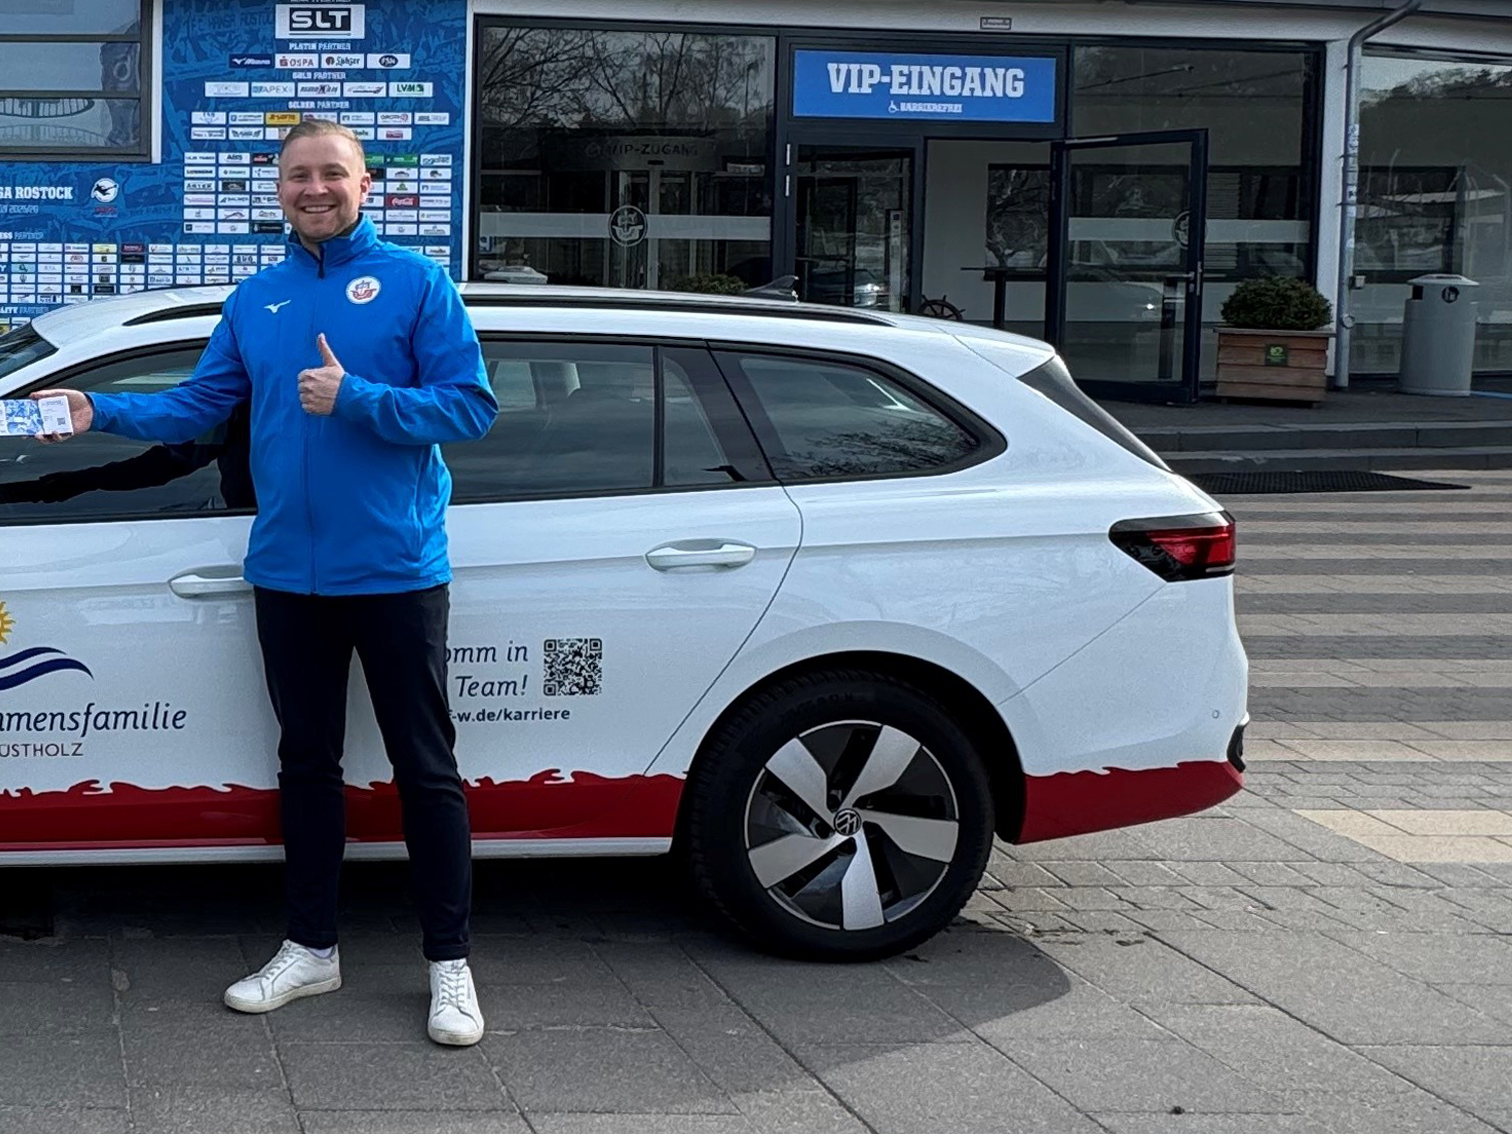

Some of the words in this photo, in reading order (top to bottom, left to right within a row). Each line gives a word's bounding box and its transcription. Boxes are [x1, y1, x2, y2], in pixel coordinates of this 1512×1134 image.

[291, 10, 349, 29] SLT
[289, 58, 314, 66] OSPA
[396, 83, 417, 93] LVM
[827, 62, 1025, 98] VIP-EINGANG
[15, 186, 73, 200] ROSTOCK
[507, 640, 528, 663] in
[455, 674, 529, 698] Team!
